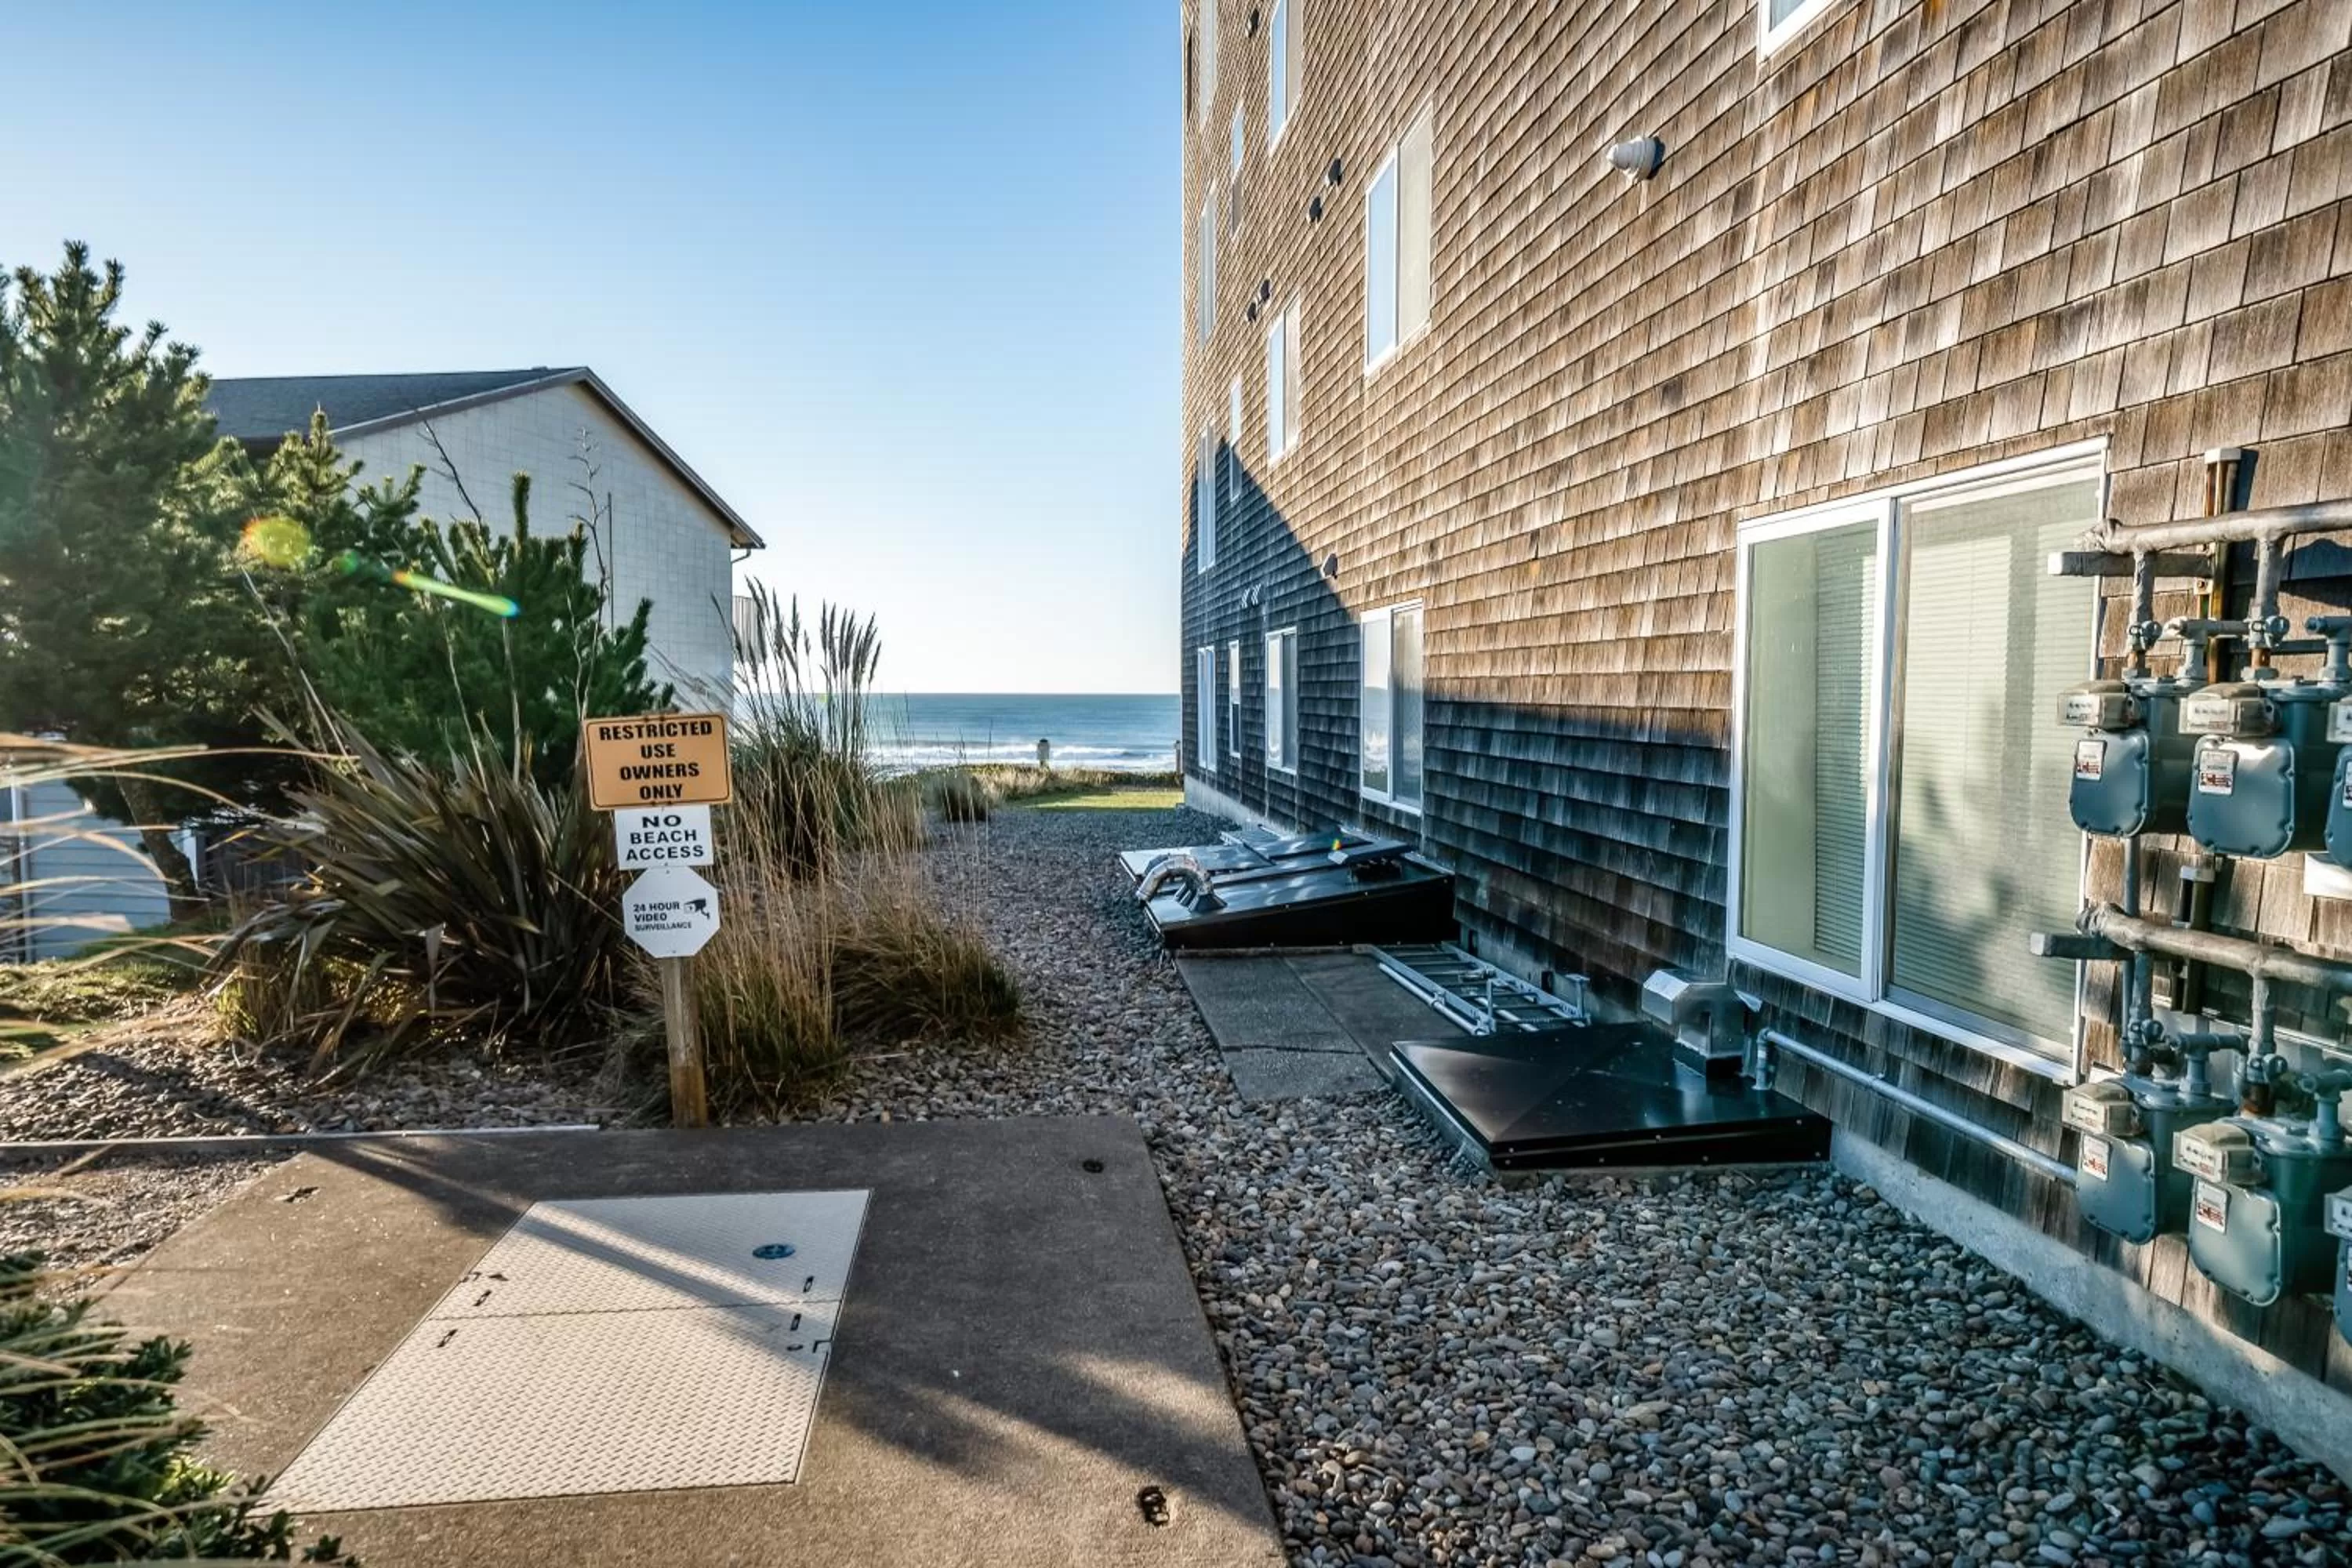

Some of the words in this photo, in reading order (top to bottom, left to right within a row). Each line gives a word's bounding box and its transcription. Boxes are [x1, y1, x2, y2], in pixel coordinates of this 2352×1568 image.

[600, 721, 712, 741] RESTRICTED
[641, 743, 675, 759] USE
[620, 763, 699, 780] OWNERS
[639, 784, 683, 800] ONLY
[642, 815, 681, 828] NO
[630, 830, 696, 844] BEACH
[626, 845, 703, 860] ACCESS
[633, 903, 647, 913] 24
[649, 902, 681, 912] HOUR
[634, 913, 667, 922] VIDEO
[634, 920, 692, 931] SURVEILLANCE
